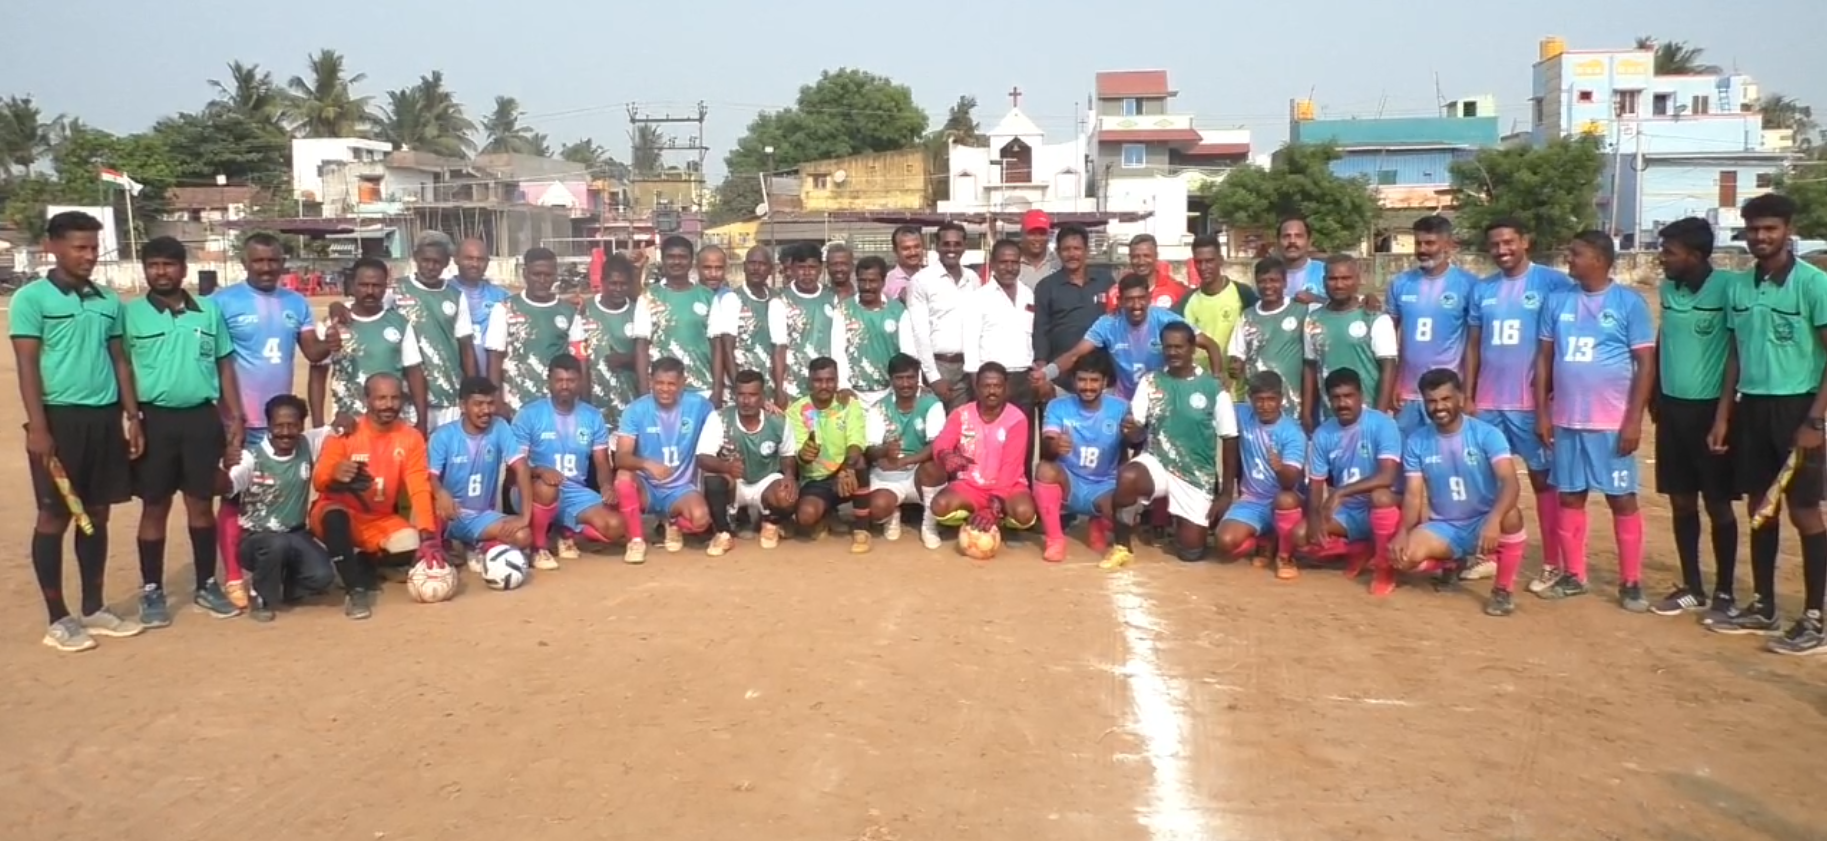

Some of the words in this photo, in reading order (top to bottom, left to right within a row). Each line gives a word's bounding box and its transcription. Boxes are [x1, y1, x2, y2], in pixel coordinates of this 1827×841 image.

[1416, 318, 1432, 341] 8
[1491, 320, 1520, 345] 16
[262, 338, 281, 363] 4
[1564, 337, 1594, 361] 13
[554, 454, 577, 476] 19
[662, 447, 679, 467] 11
[1080, 447, 1099, 467] 18
[468, 474, 481, 496] 6
[1449, 477, 1466, 500] 9
[1612, 470, 1628, 487] 13
